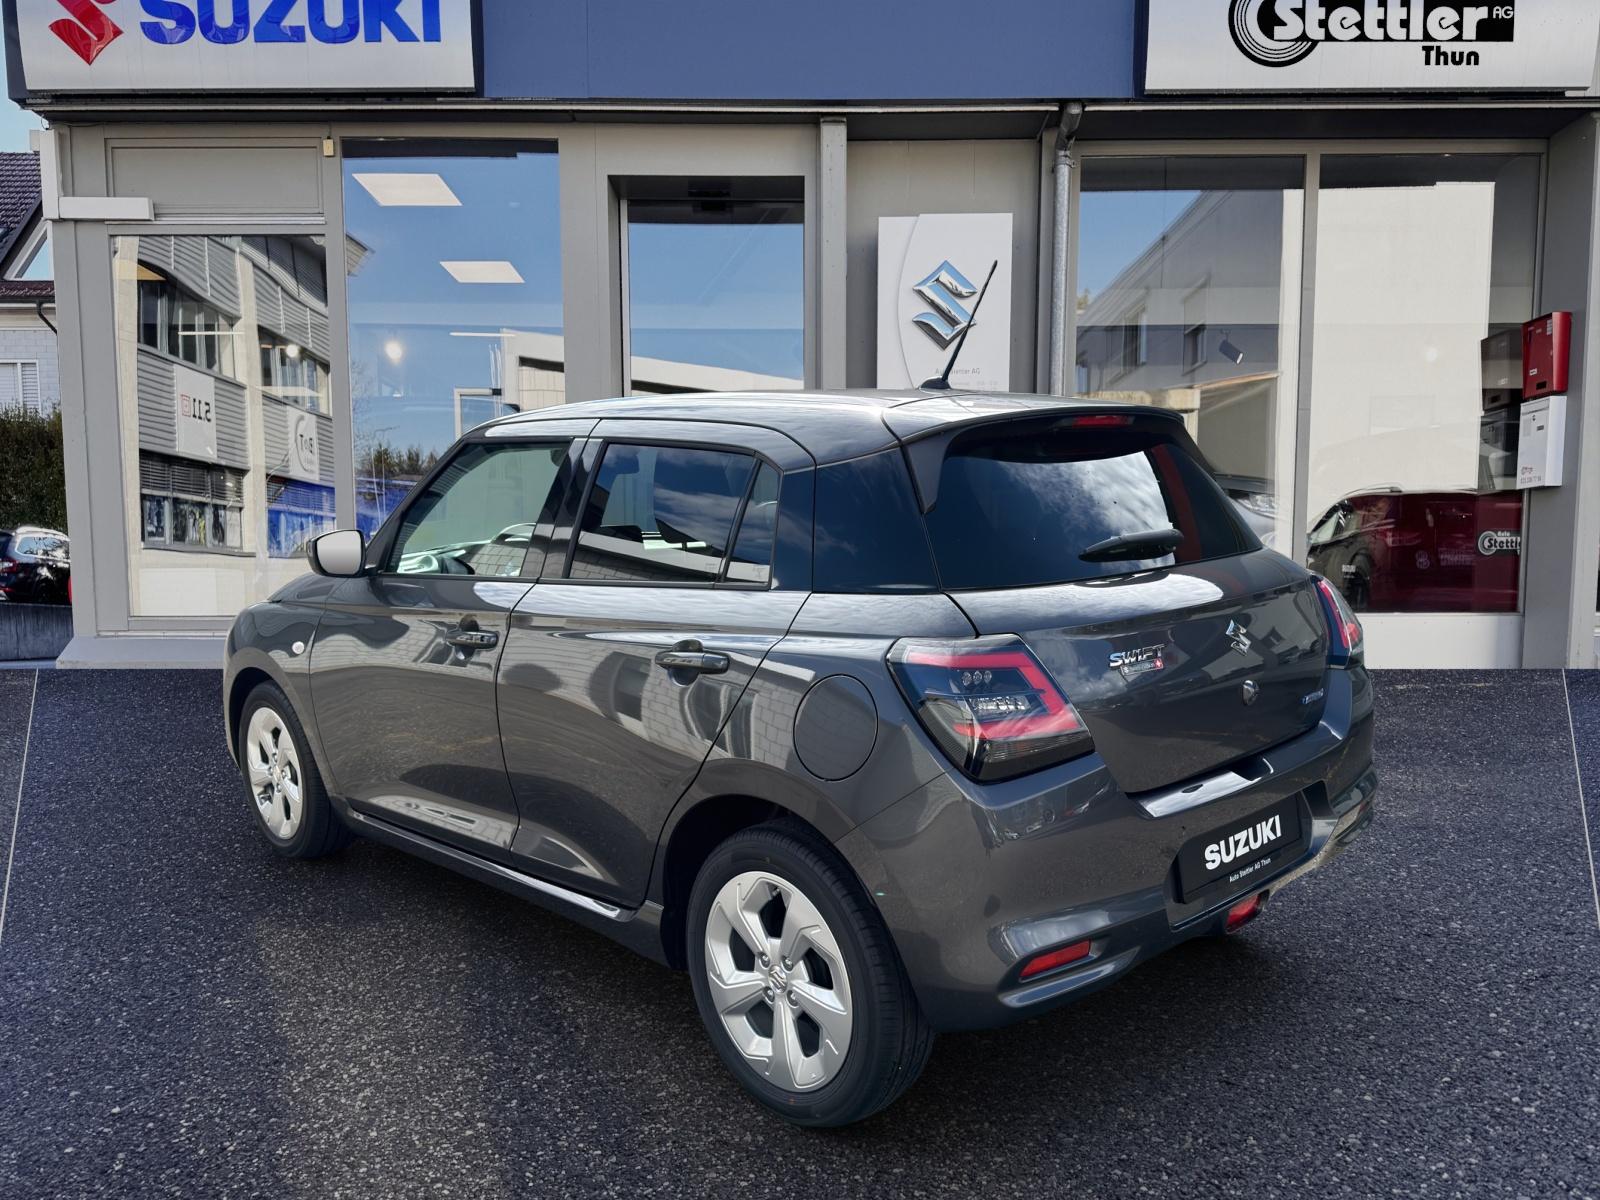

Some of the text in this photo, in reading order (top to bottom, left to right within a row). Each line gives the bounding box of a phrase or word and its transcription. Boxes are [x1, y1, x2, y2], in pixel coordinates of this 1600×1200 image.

[140, 0, 441, 44] SUZUKI
[1274, 0, 1514, 41] Stettler AG
[1422, 45, 1480, 66] Thun
[1486, 537, 1520, 549] Stettl
[1109, 644, 1165, 667] SWIFT
[1204, 814, 1282, 870] SUZUKI
[1229, 858, 1271, 883] Auto Stettler AG Thun
